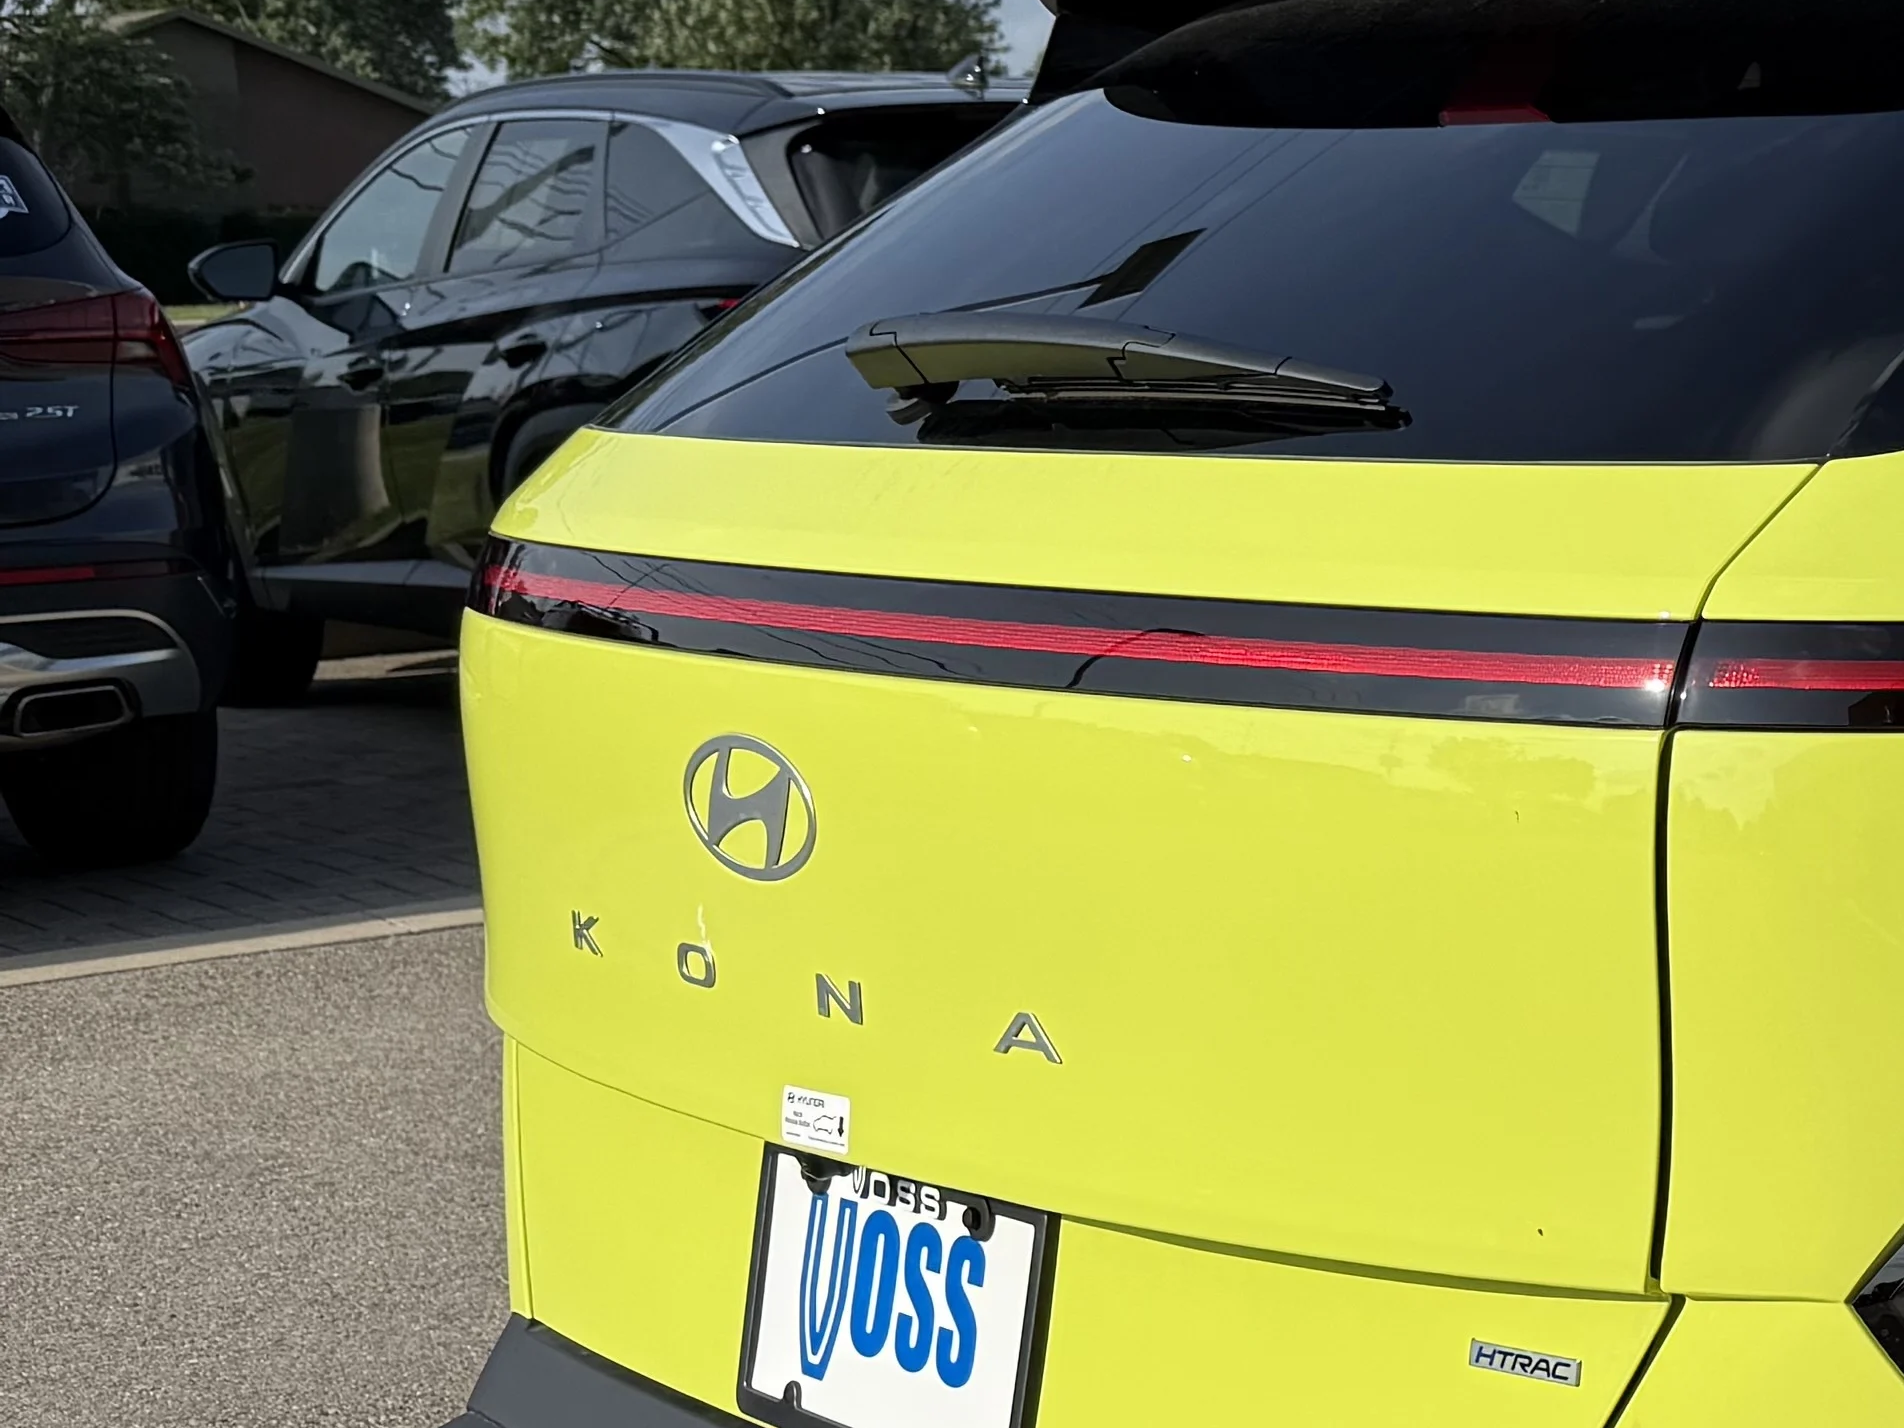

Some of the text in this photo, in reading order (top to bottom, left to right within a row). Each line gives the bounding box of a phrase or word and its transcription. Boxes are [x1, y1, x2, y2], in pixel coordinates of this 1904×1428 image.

[570, 909, 1063, 1065] KONA
[799, 1193, 986, 1388] VOSS
[1475, 1345, 1572, 1381] HTRAC
